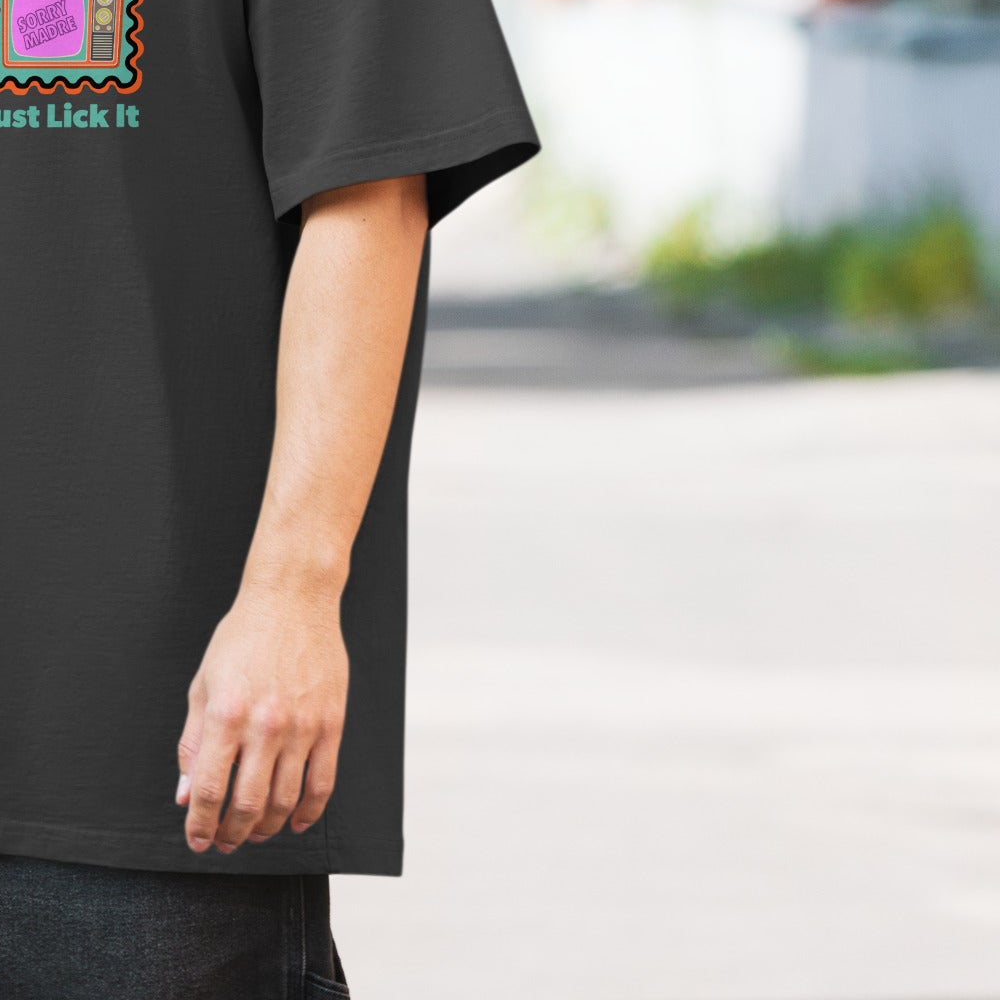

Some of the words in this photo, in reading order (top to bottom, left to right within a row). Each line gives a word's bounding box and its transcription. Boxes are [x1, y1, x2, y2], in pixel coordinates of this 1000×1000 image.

[16, 0, 67, 33] SORRY
[23, 16, 77, 50] MADRE
[47, 102, 110, 128] Lick
[116, 103, 140, 128] It
